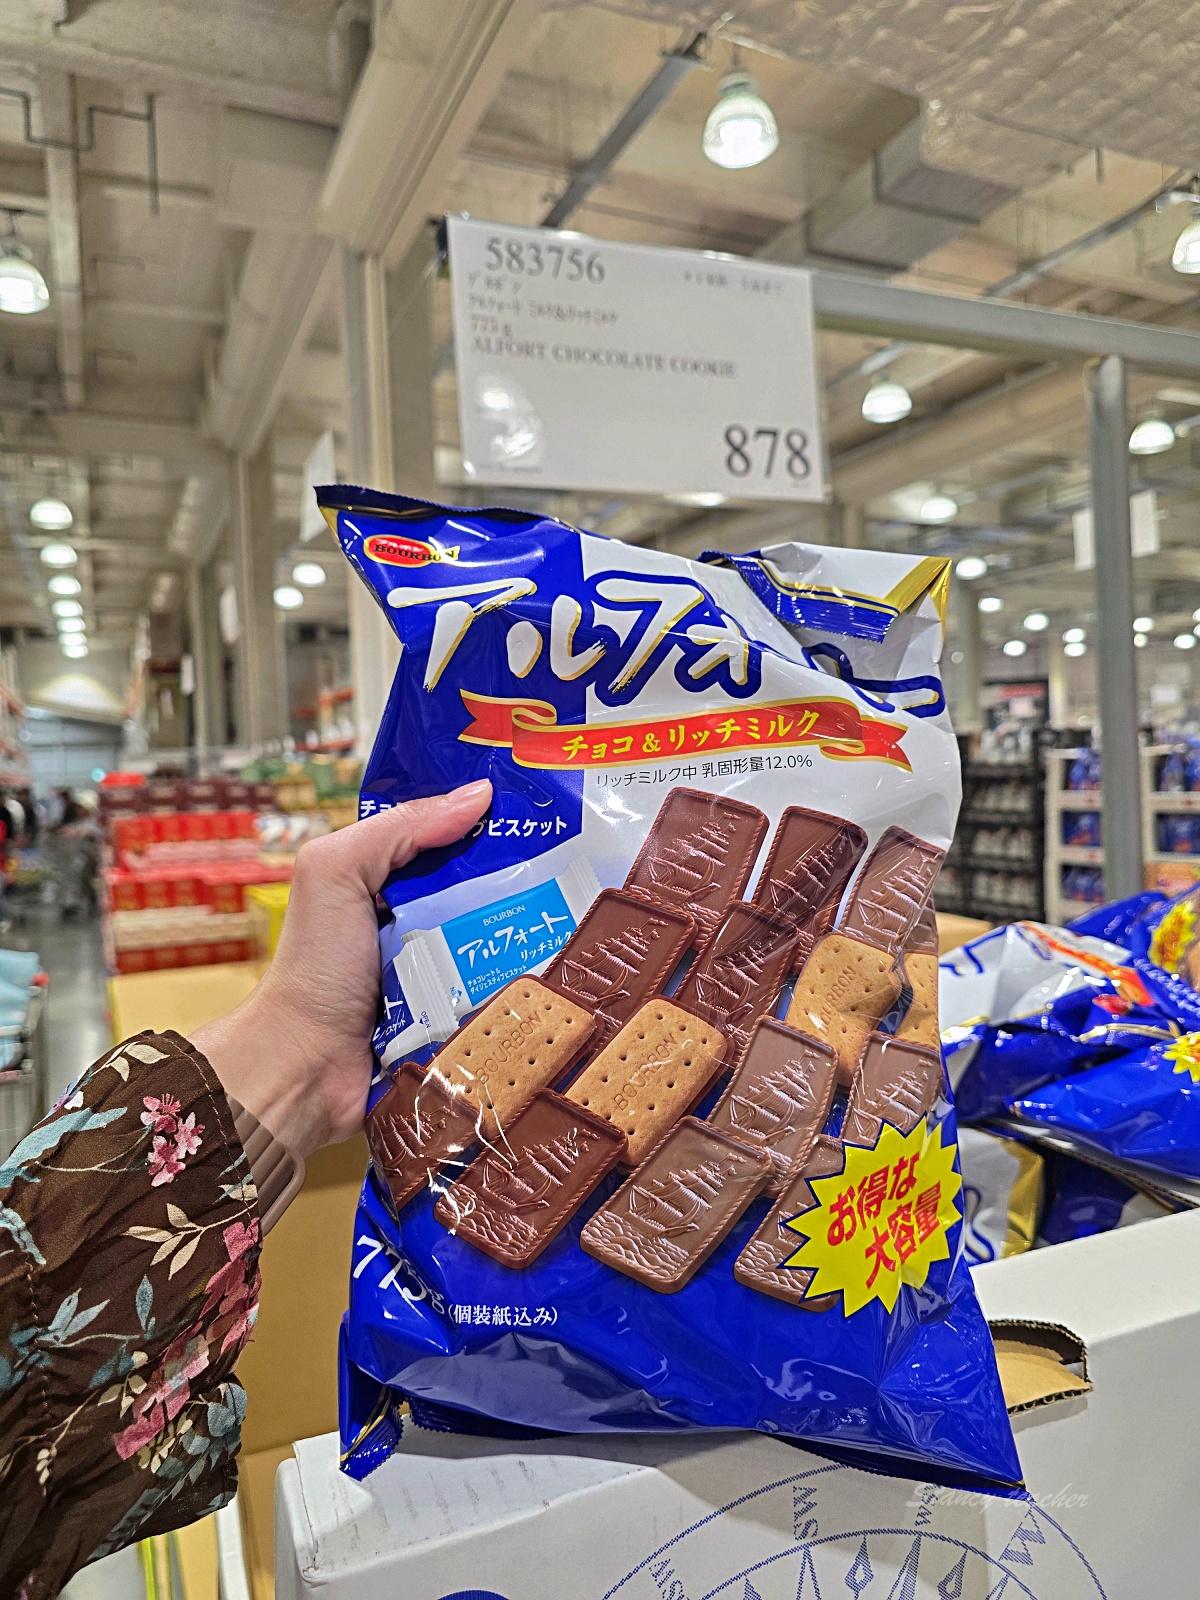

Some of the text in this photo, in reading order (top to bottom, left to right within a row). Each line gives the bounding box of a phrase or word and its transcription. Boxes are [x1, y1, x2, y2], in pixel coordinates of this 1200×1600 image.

[484, 237, 606, 285] 583756
[474, 335, 737, 380] ALFORT CHOCOLATE COOKIE
[723, 424, 812, 481] 878
[597, 754, 813, 788] リッチミルク中 乳固形量12.0%
[457, 911, 569, 968] アルフォート
[483, 904, 526, 927] BOURBON
[520, 931, 572, 962] リッチミルク
[421, 1010, 431, 1028] OPEN
[475, 1011, 542, 1085] BOURBON
[613, 1032, 678, 1112] BOURBON
[827, 1151, 920, 1247] お得な
[865, 1180, 942, 1290] 大容量
[448, 1304, 558, 1327] (個装紙込み)
